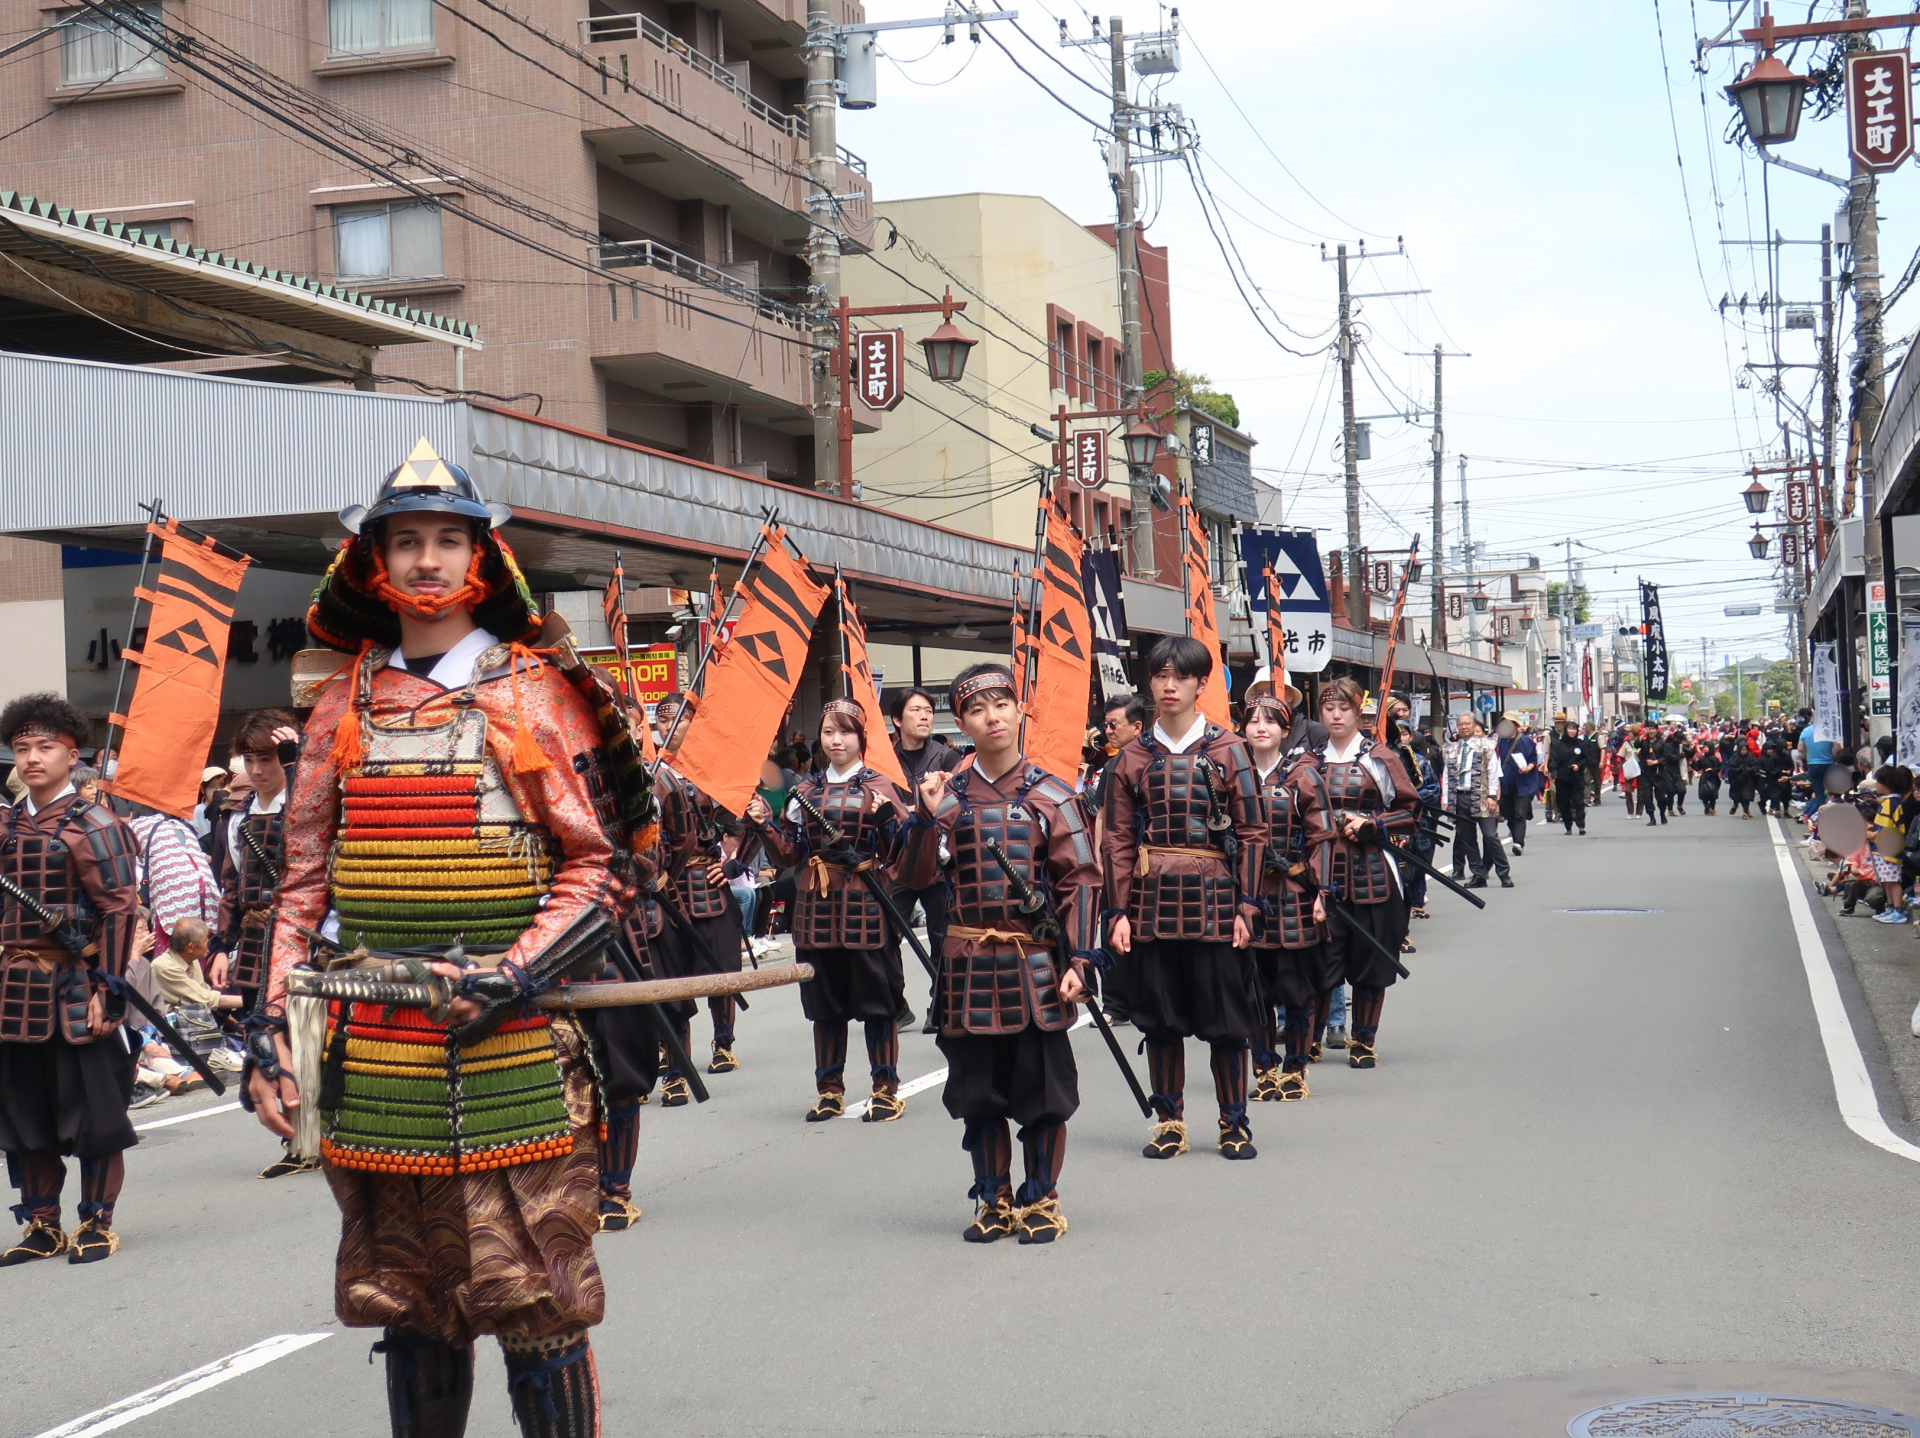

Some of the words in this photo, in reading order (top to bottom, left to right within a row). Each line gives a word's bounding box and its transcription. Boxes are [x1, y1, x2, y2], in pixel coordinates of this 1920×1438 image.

[1864, 67, 1896, 154] 大工町
[868, 341, 888, 400] 大工町
[1082, 437, 1097, 482] 大工町
[1791, 485, 1803, 518] 大工町
[1785, 537, 1795, 564] 大工町
[1378, 565, 1386, 590] 大工町
[1452, 597, 1460, 617] 大工町
[1873, 613, 1889, 675] 大林医院
